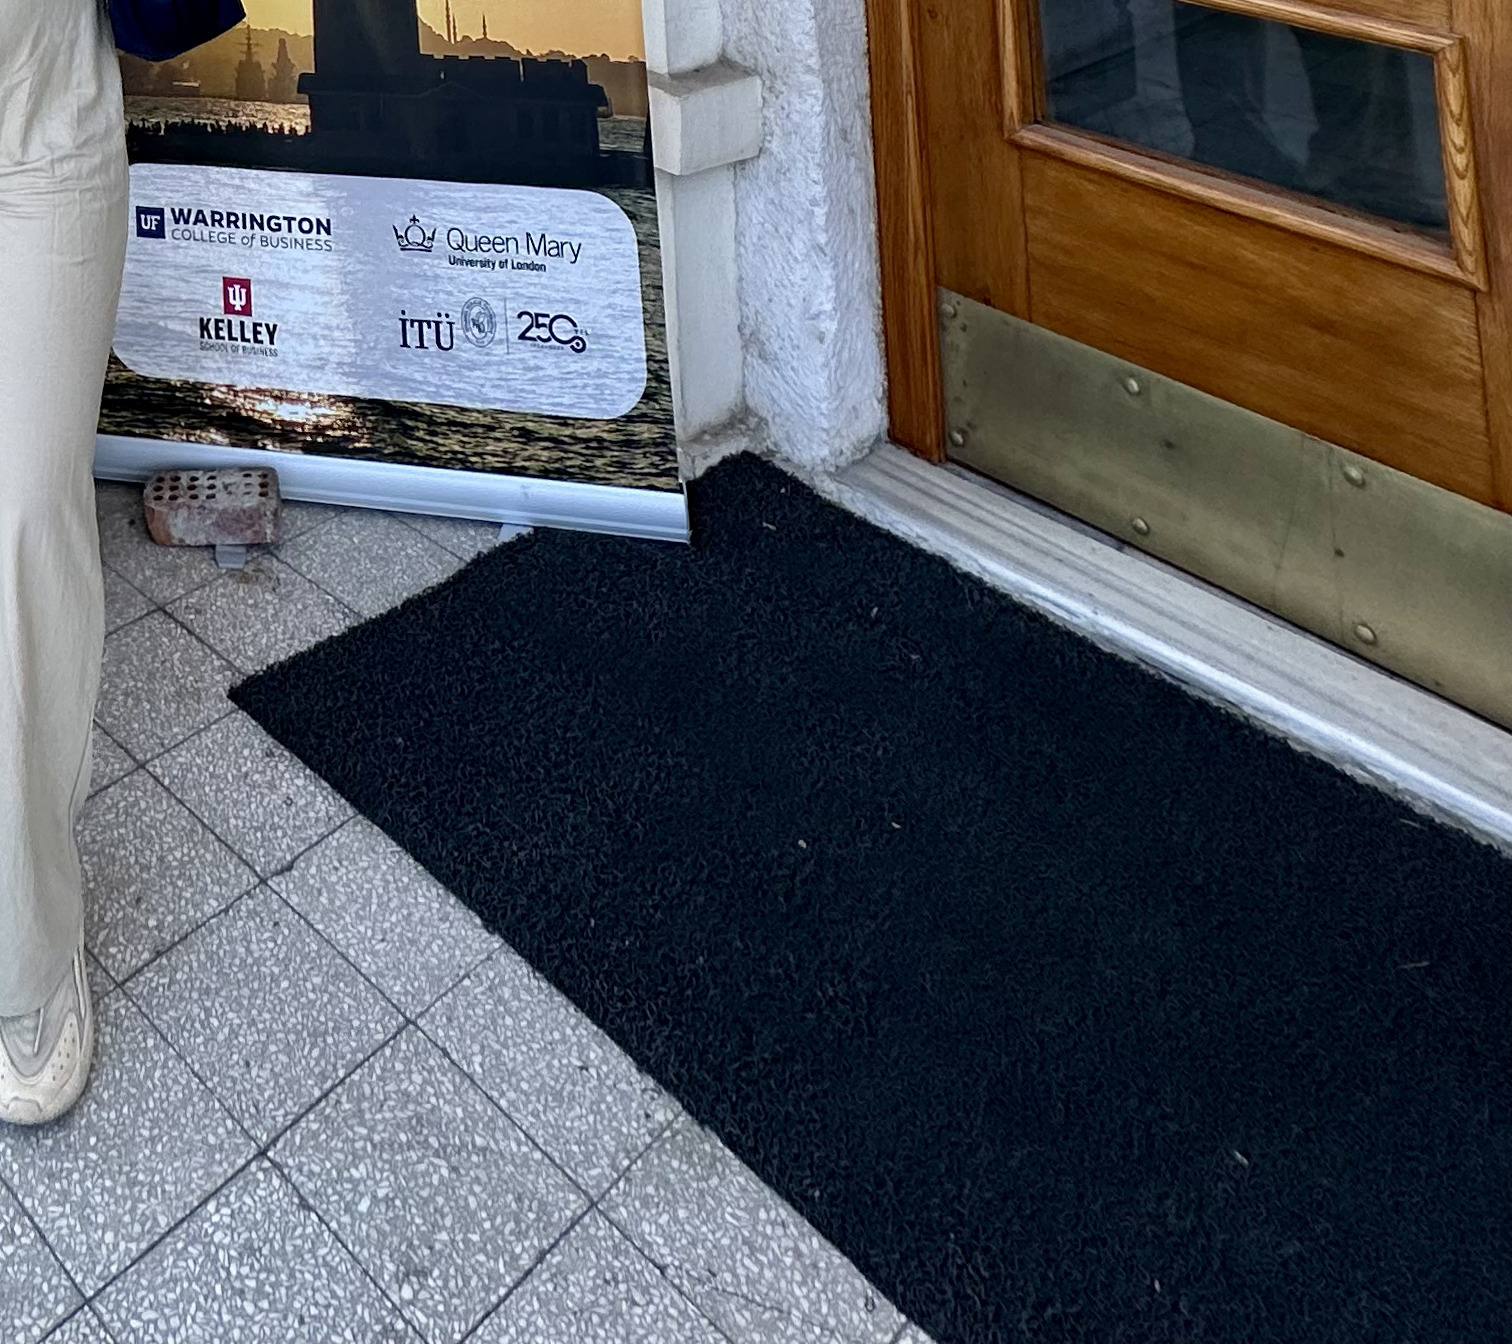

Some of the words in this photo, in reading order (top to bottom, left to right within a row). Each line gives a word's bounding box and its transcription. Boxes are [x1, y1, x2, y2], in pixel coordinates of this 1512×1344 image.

[140, 214, 161, 231] UF
[170, 207, 332, 236] WARRINGTON
[171, 227, 237, 244] COLLEGE
[241, 234, 256, 248] of
[260, 238, 333, 252] BUSINESS
[447, 227, 519, 254] Queen
[526, 232, 582, 264] Mary
[448, 254, 496, 272] University
[499, 260, 508, 269] of
[511, 261, 547, 272] London
[199, 317, 278, 345] KELLEY
[399, 310, 455, 351] İTÜ
